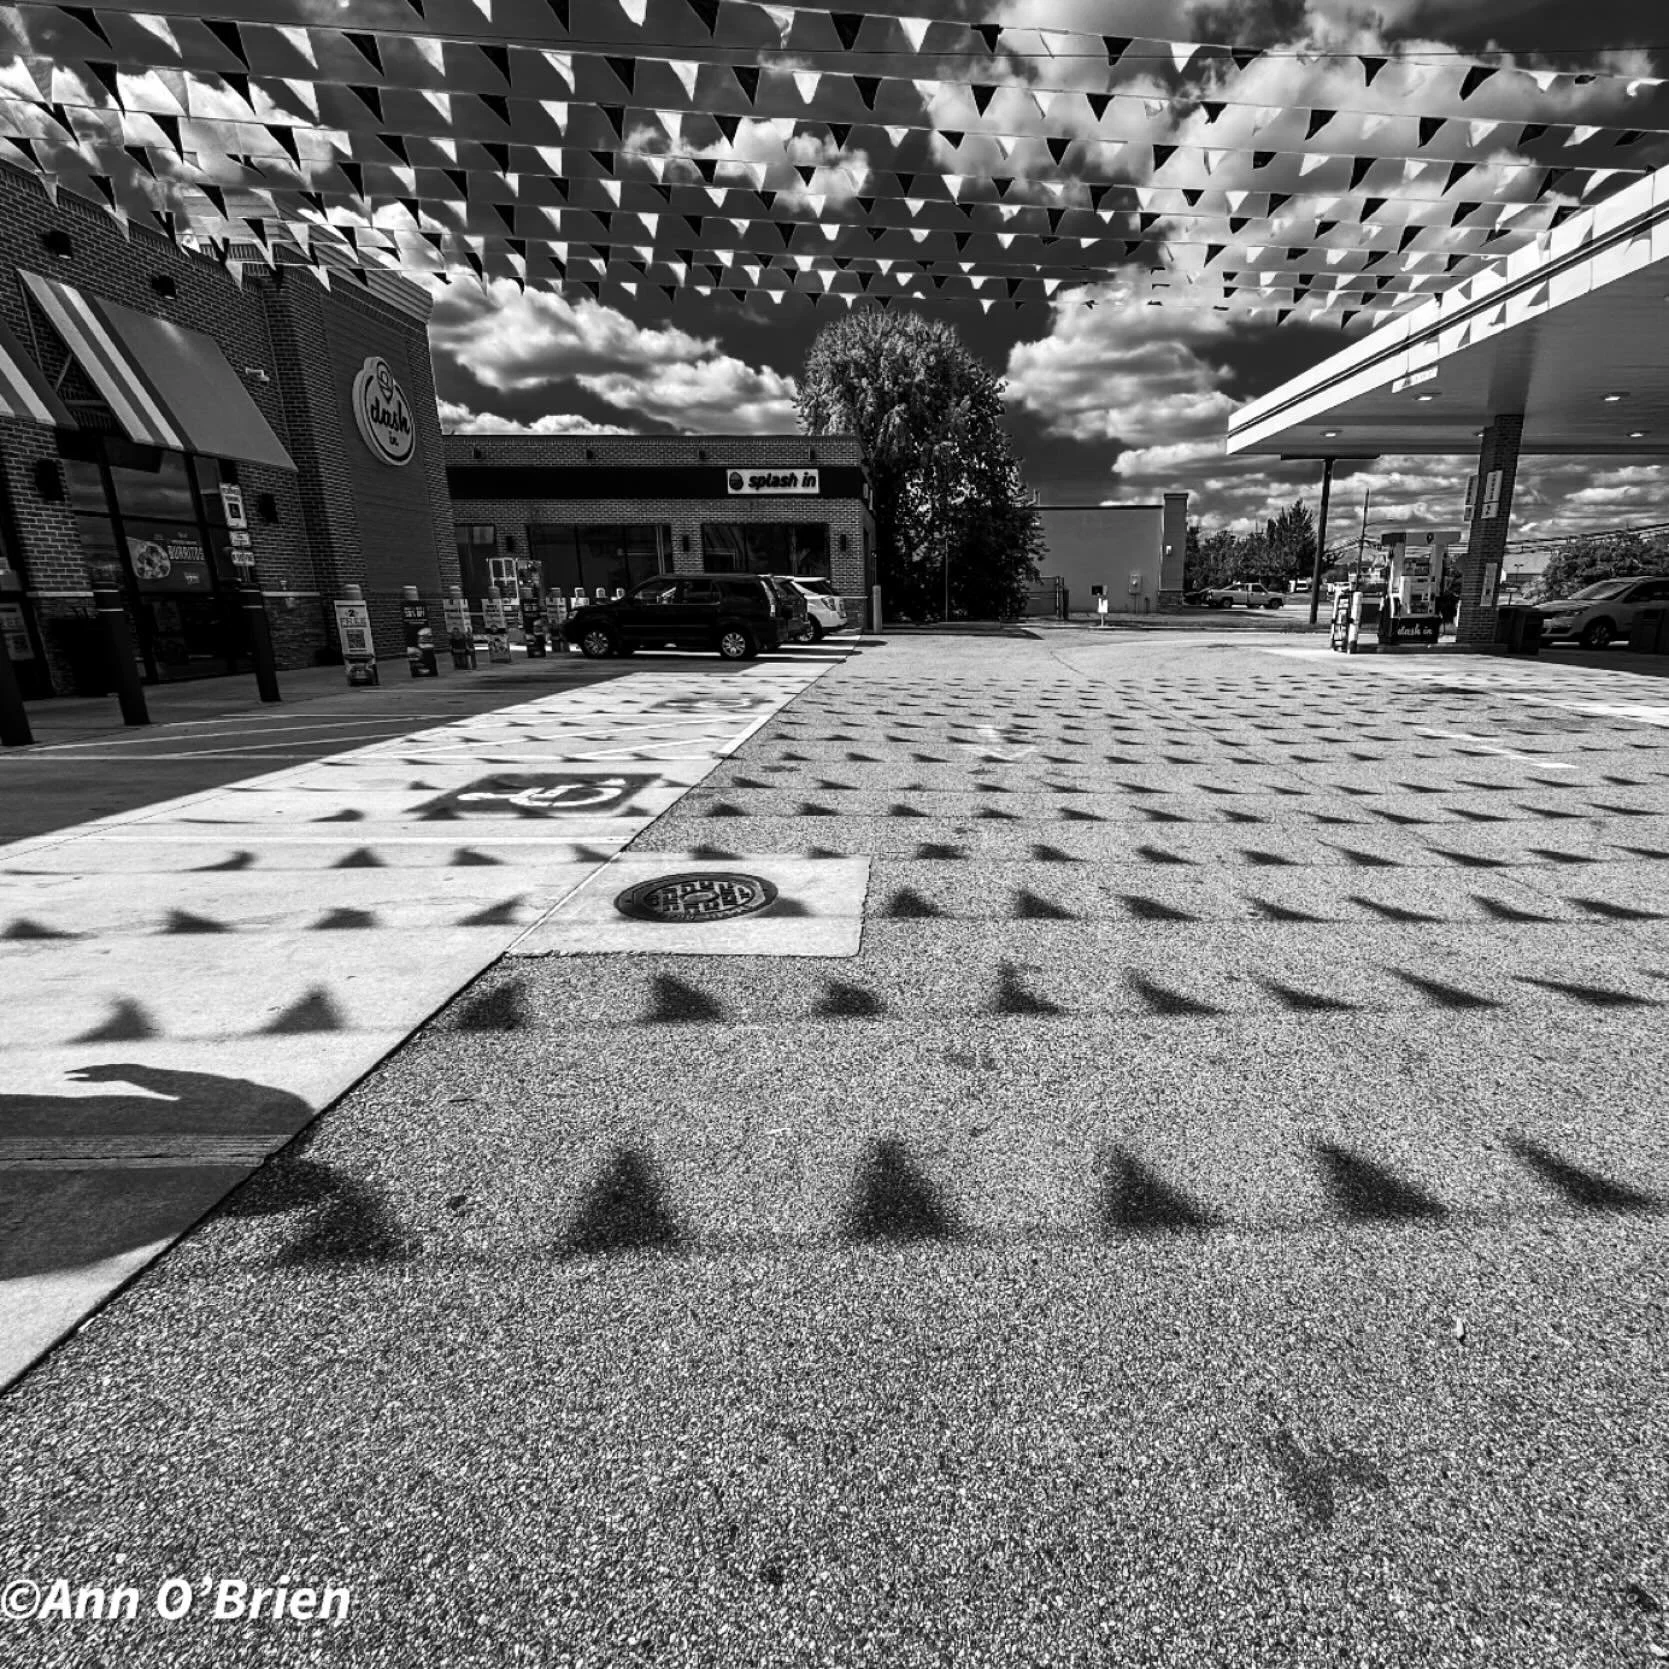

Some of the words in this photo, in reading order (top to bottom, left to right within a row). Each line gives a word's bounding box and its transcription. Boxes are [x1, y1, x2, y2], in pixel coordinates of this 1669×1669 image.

[370, 396, 411, 434] dash
[748, 472, 798, 490] splash
[802, 472, 816, 488] in
[1397, 623, 1422, 636] dash
[1422, 626, 1433, 636] in
